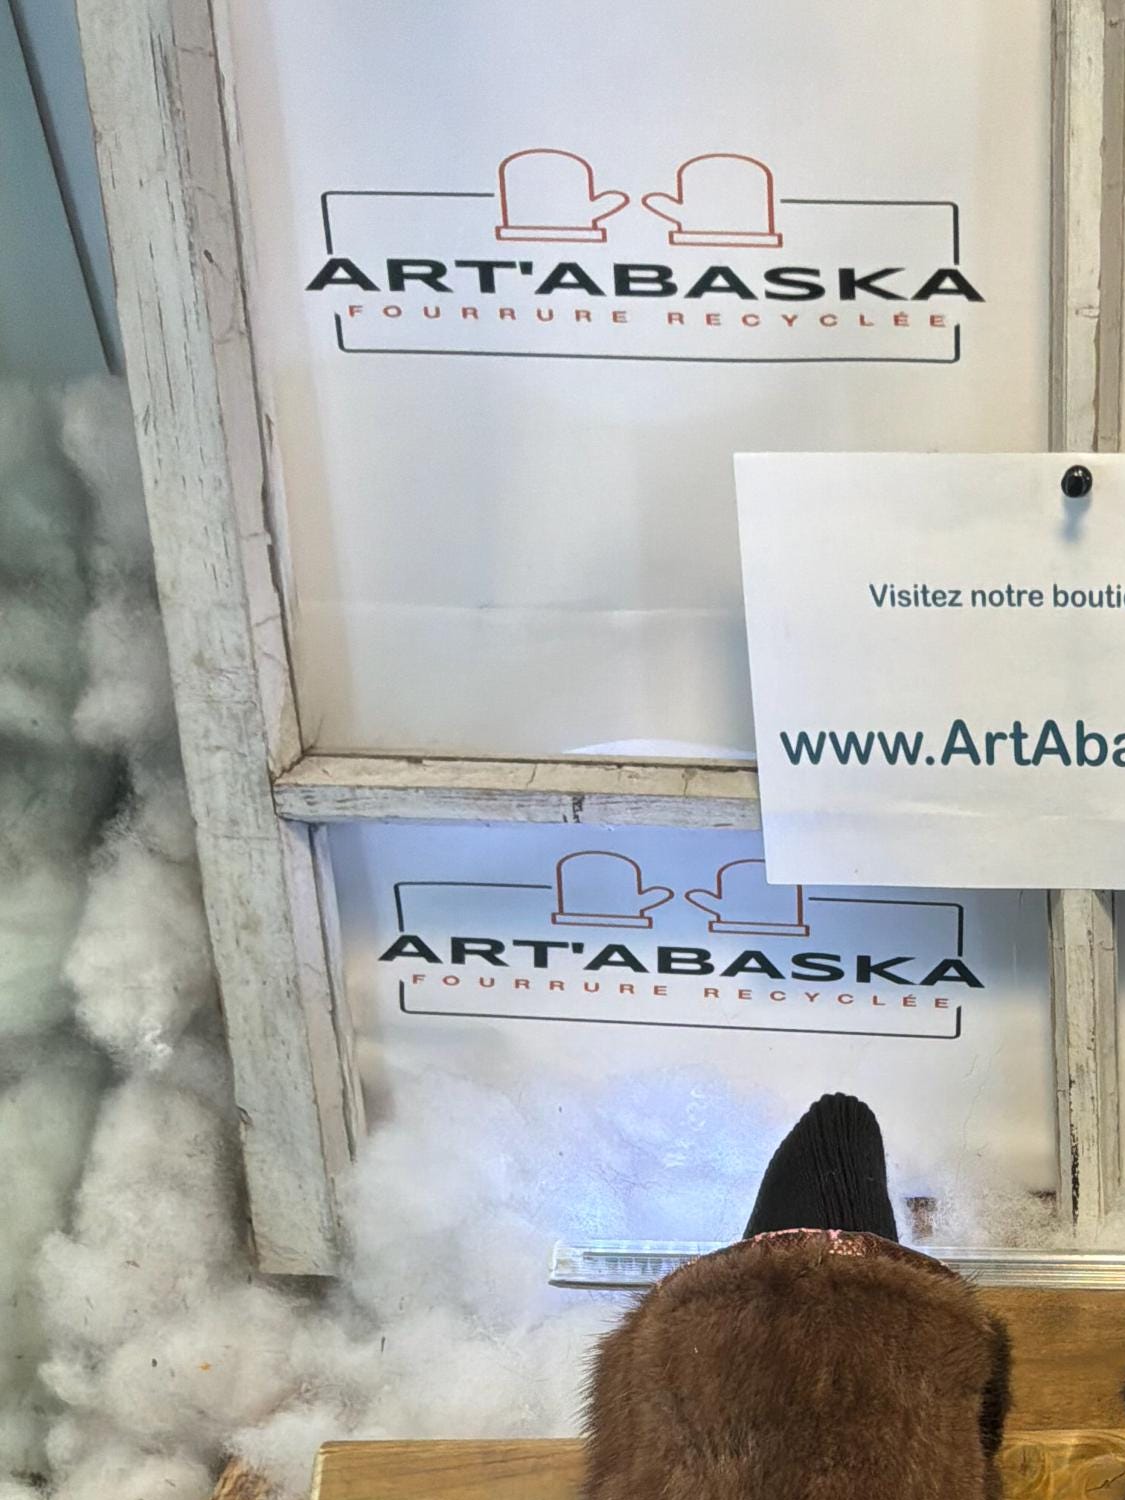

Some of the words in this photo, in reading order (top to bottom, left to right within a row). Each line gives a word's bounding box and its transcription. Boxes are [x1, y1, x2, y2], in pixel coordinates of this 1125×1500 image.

[306, 258, 986, 303] ART'ABASKA
[347, 304, 629, 324] FOURRURE
[667, 310, 947, 329] RECYCLÉE
[869, 583, 963, 608] Visitez
[971, 583, 1044, 608] notre
[378, 934, 985, 989] ART'ABASKA
[411, 973, 668, 997] FOURRURE
[703, 986, 951, 1009] RECYCLÉE
